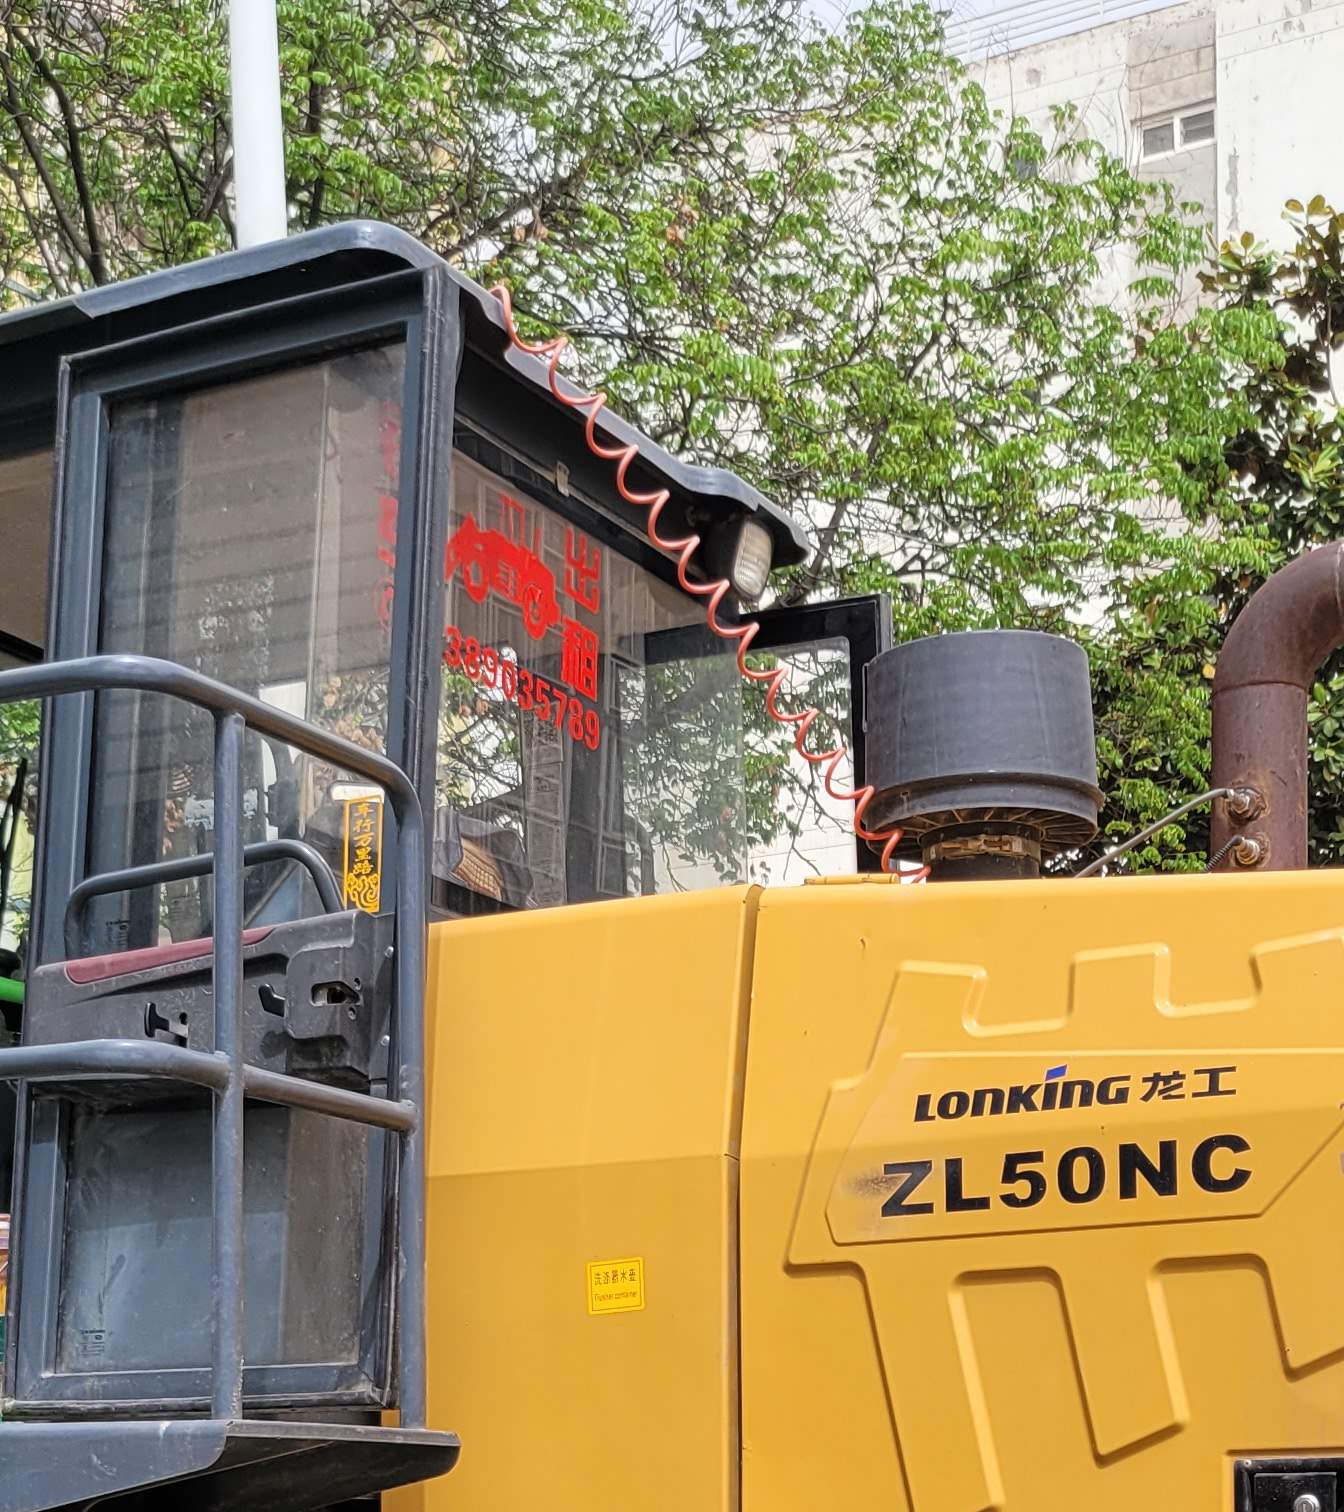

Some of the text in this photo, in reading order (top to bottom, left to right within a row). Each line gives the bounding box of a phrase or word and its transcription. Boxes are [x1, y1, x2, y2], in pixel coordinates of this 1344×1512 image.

[561, 527, 601, 701] 出租
[1140, 1066, 1237, 1102] 龙工
[881, 1133, 1253, 1217] ZL50NC
